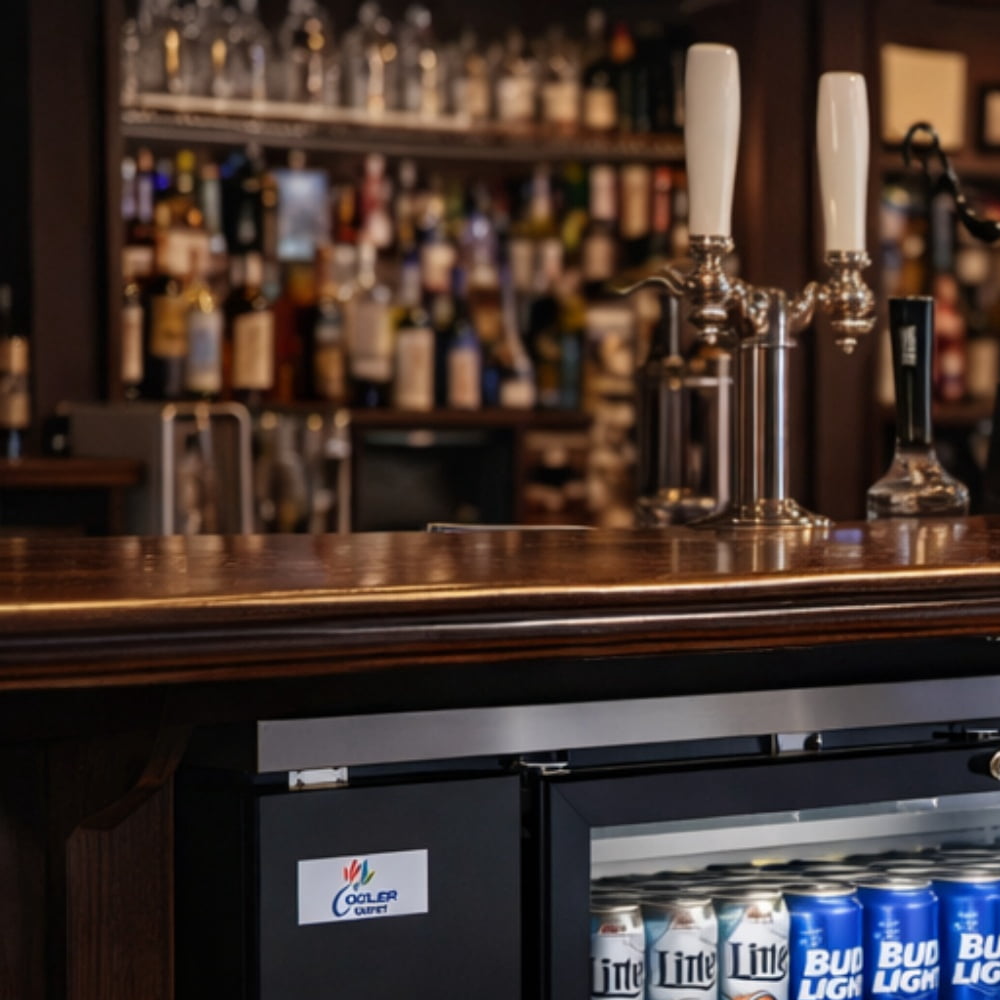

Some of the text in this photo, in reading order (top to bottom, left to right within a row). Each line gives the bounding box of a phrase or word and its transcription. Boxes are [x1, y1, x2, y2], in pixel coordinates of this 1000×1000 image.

[804, 946, 863, 976] BUD
[878, 939, 939, 968] BUD
[798, 974, 863, 1000] LIGH
[872, 966, 940, 993] LIGH
